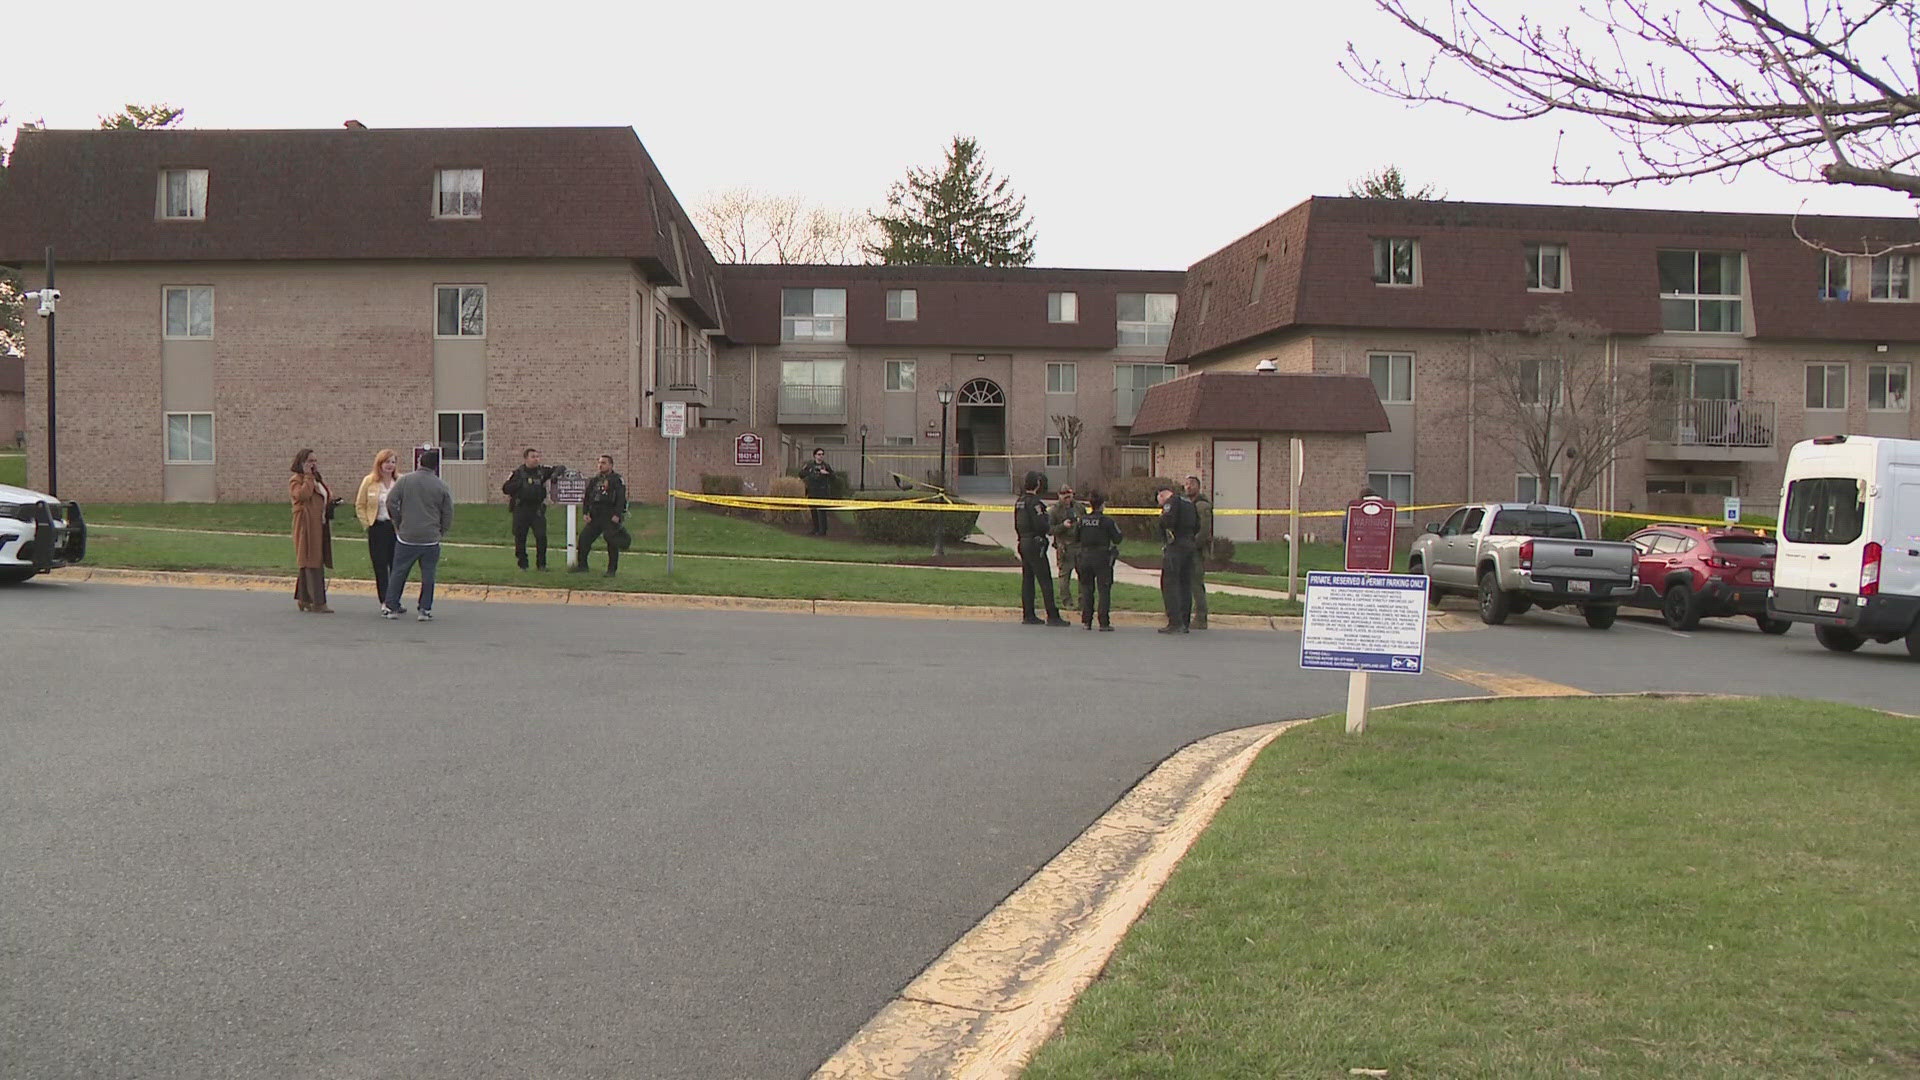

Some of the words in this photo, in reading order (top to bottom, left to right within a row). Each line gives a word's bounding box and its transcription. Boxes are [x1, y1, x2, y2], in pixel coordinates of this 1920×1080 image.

[1082, 518, 1100, 526] POLICE
[1354, 517, 1389, 528] WARNING
[1310, 575, 1332, 585] PRIVATE,
[1332, 575, 1360, 586] RESERVED
[1360, 576, 1365, 586] &
[1365, 577, 1385, 587] PERMIT
[1385, 577, 1409, 587] PARKING
[1409, 578, 1424, 588] ONLY
